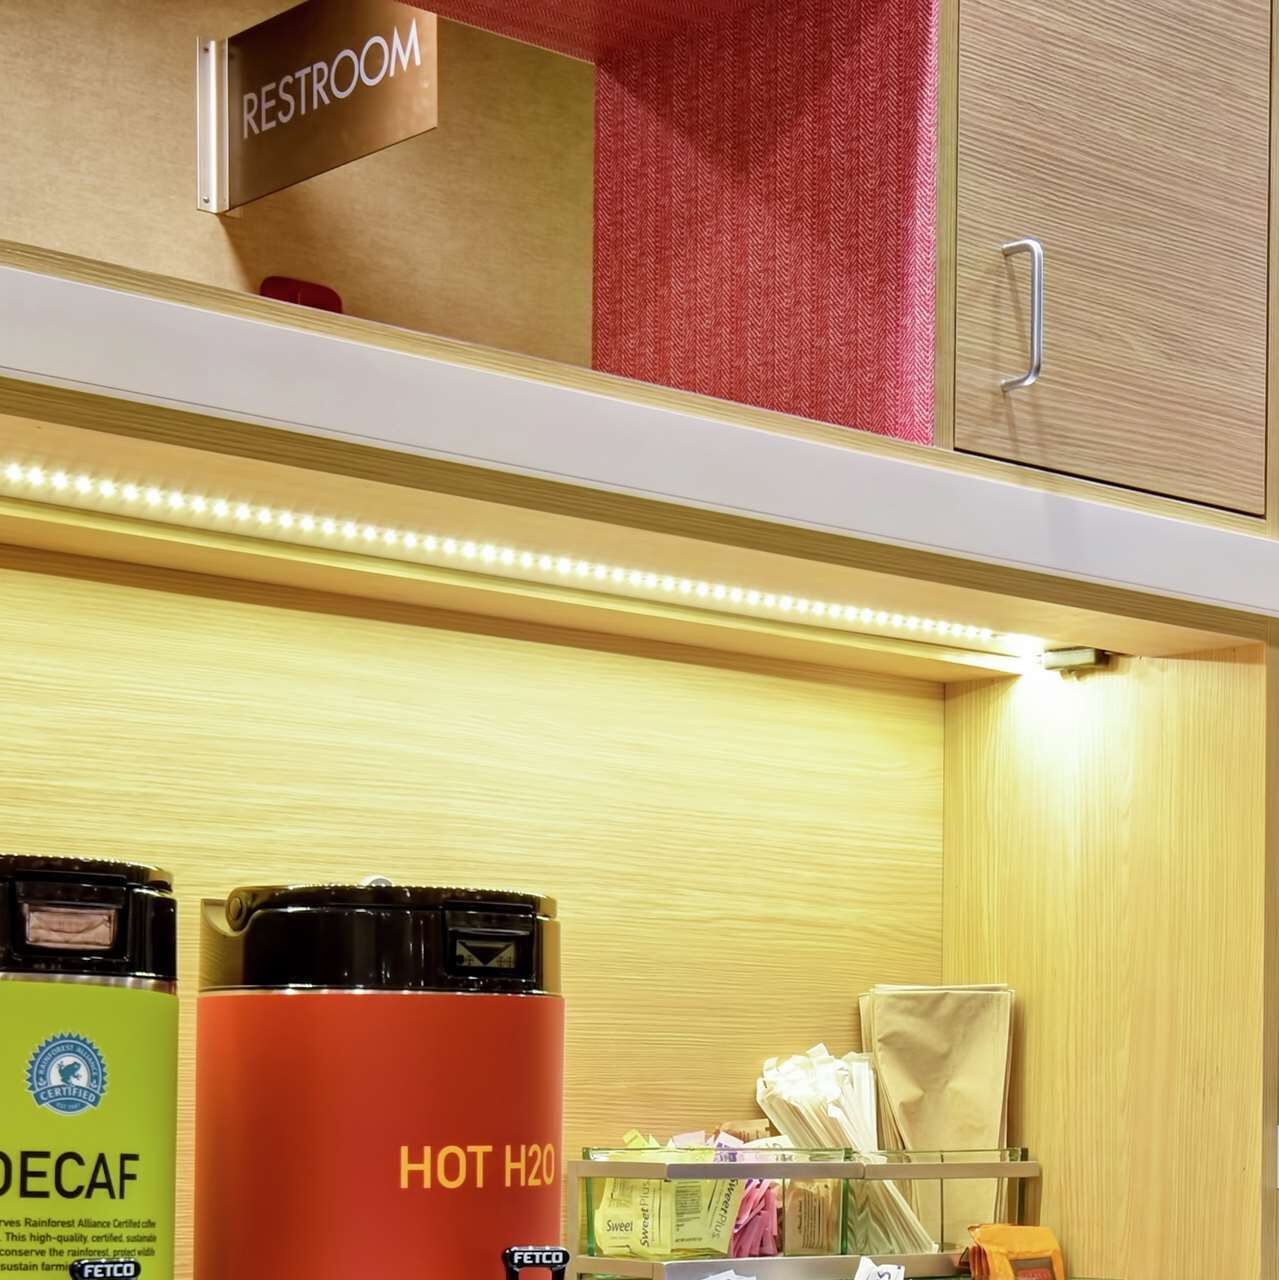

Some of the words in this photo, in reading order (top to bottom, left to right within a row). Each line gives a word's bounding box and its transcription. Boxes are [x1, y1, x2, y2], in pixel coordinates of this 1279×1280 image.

[243, 16, 422, 140] RESTROOM
[38, 1044, 75, 1075] RAINFOREST
[39, 1086, 96, 1102] CERTIFIED
[400, 1145, 493, 1189] HOT
[24, 1217, 75, 1228] Rainforest
[77, 1218, 111, 1228] Alliance
[5, 1231, 27, 1242] This
[48, 1247, 65, 1257] the
[513, 1251, 564, 1265] FETCO
[0, 1261, 38, 1272] sustain
[41, 1261, 70, 1273] farmi
[84, 1263, 136, 1278] FETCO
